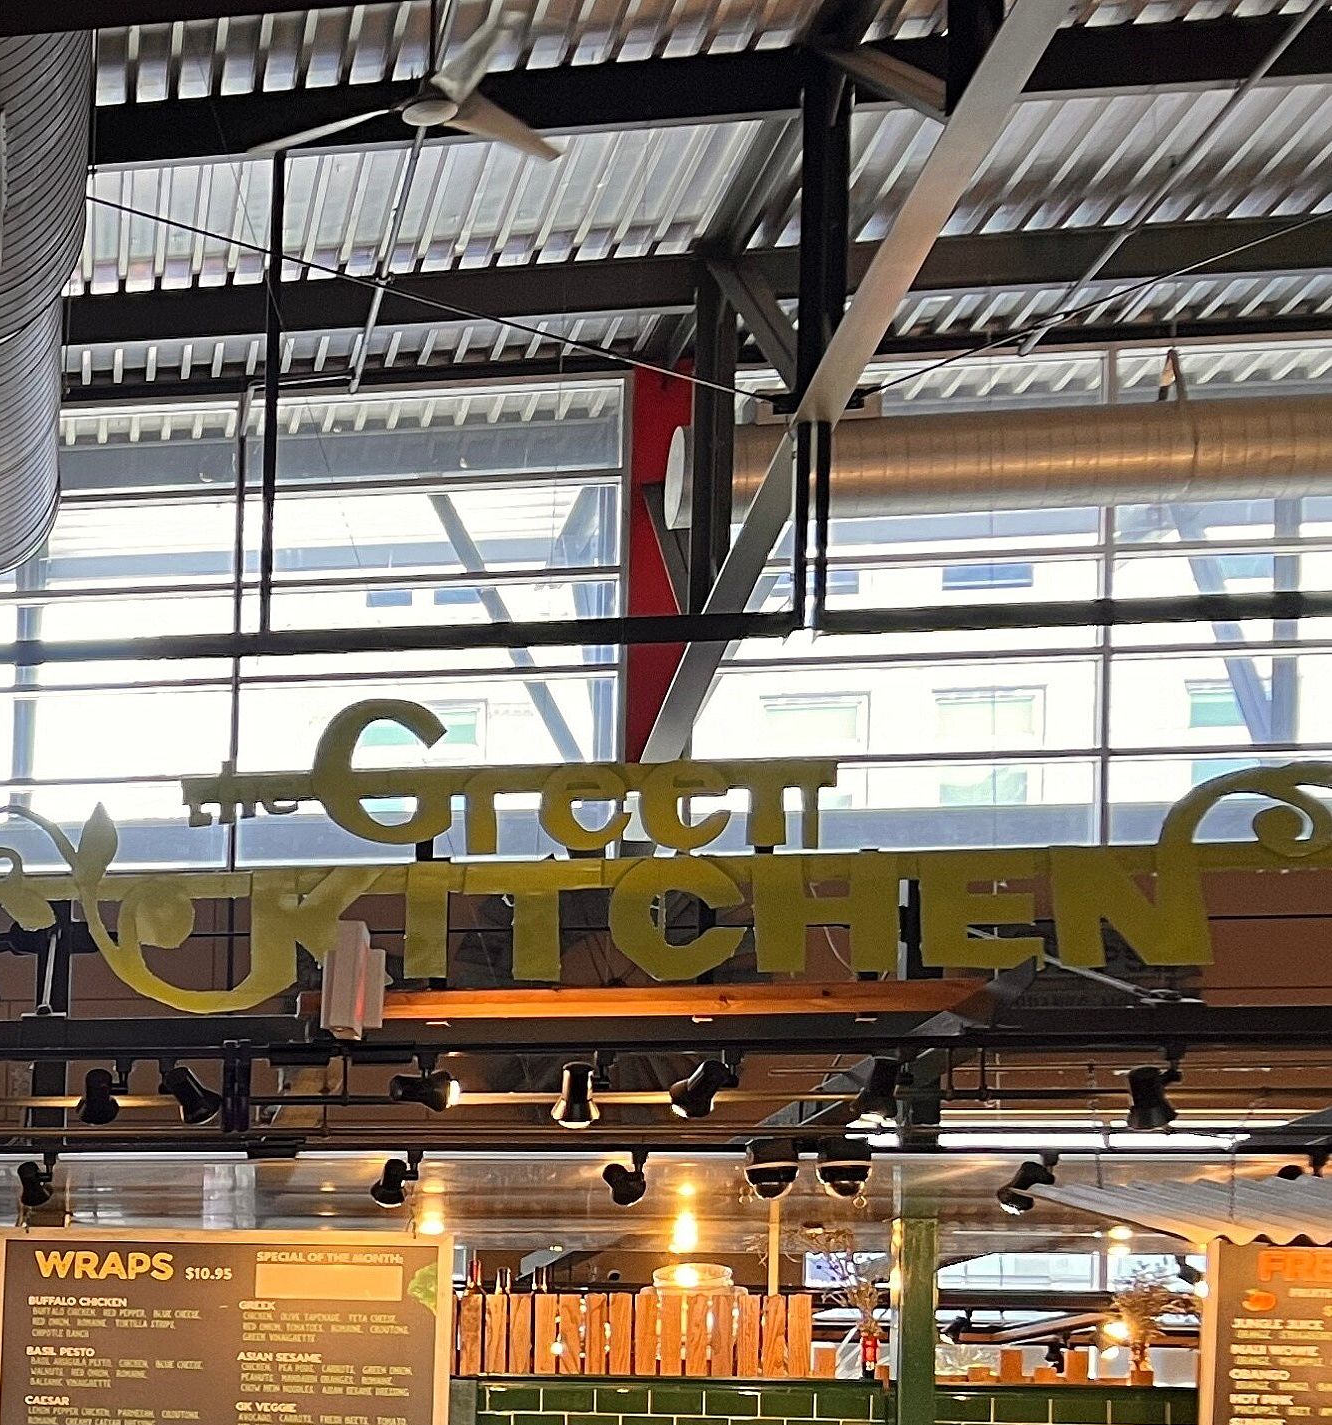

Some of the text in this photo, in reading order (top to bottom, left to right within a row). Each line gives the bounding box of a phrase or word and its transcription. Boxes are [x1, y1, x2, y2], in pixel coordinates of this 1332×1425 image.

[313, 698, 837, 853] Green
[247, 852, 1213, 992] KITCHEN
[256, 1251, 306, 1262] SPECIAL
[307, 1252, 325, 1262] OF
[329, 1253, 351, 1263] THE
[35, 1250, 174, 1281] WRAPS
[185, 1267, 233, 1281] $10.95
[28, 1296, 127, 1308] BUFFALO CHICKEN
[238, 1301, 276, 1311] GREEK
[26, 1346, 95, 1357] BASIL PESTO
[237, 1351, 322, 1363] ASIAN SESAME
[25, 1396, 70, 1406] CAESAR
[235, 1402, 297, 1413] GK VEGGIE
